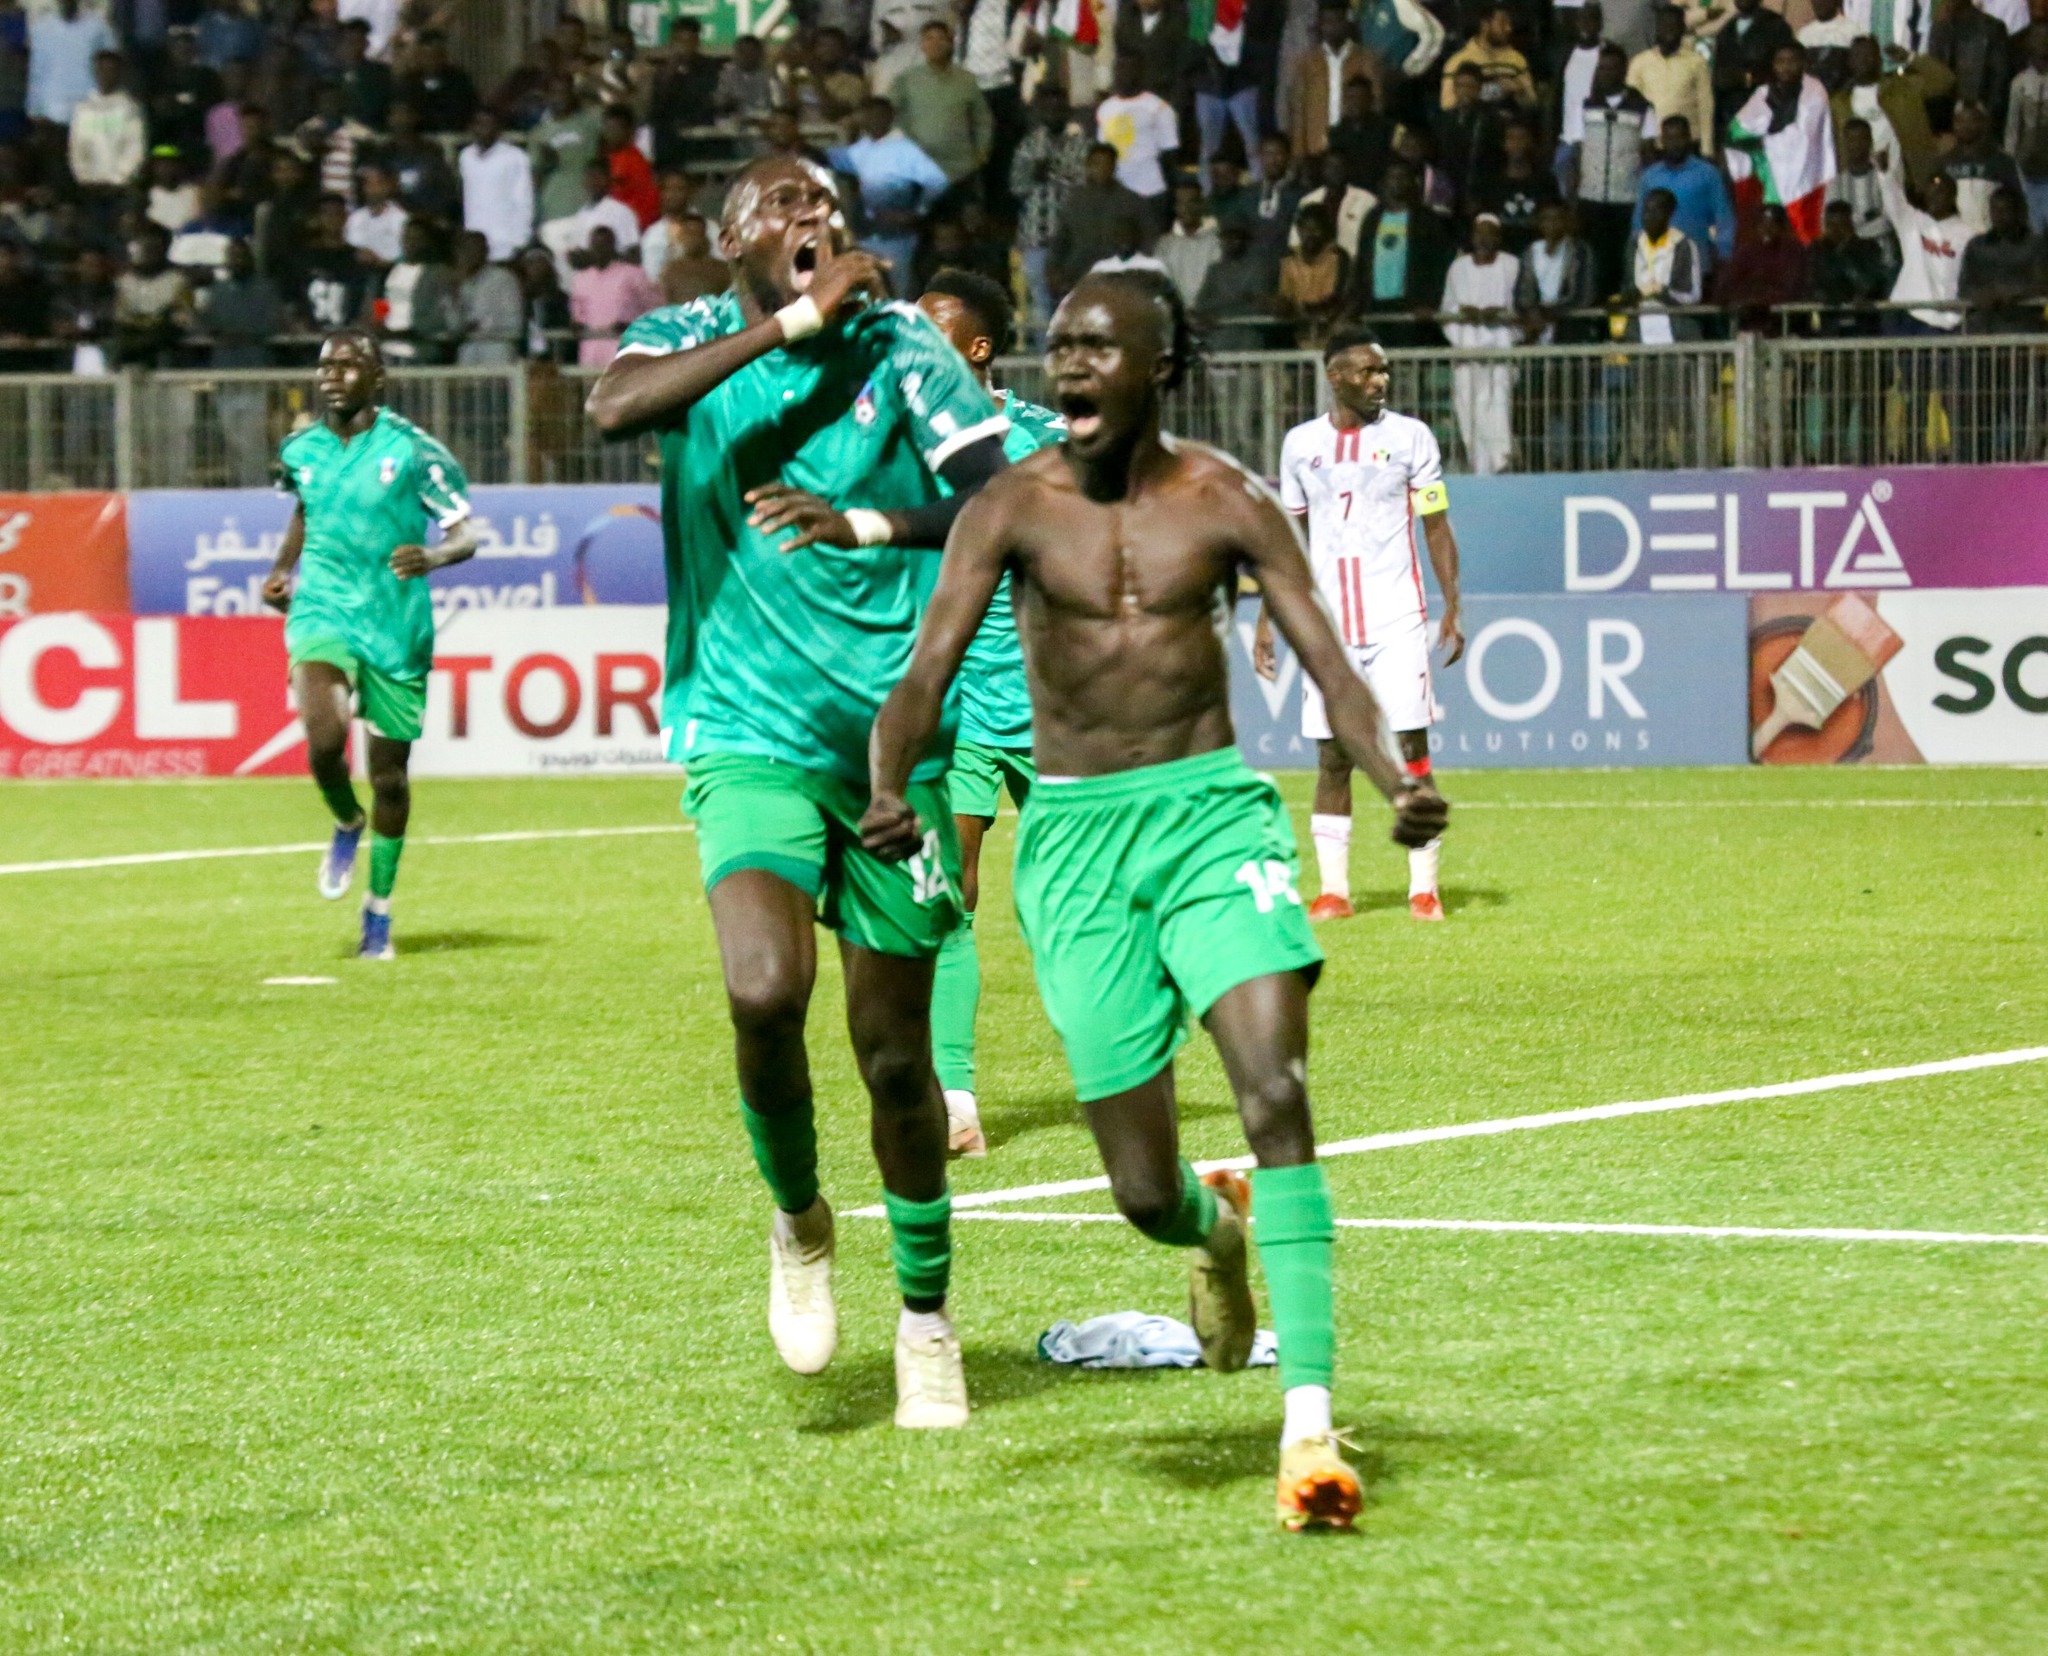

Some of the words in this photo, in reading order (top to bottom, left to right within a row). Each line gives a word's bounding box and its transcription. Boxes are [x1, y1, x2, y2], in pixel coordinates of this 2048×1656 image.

[1339, 491, 1353, 522] 7
[1564, 491, 1912, 591] DELTA
[1426, 729, 1650, 754] OLUTIONS
